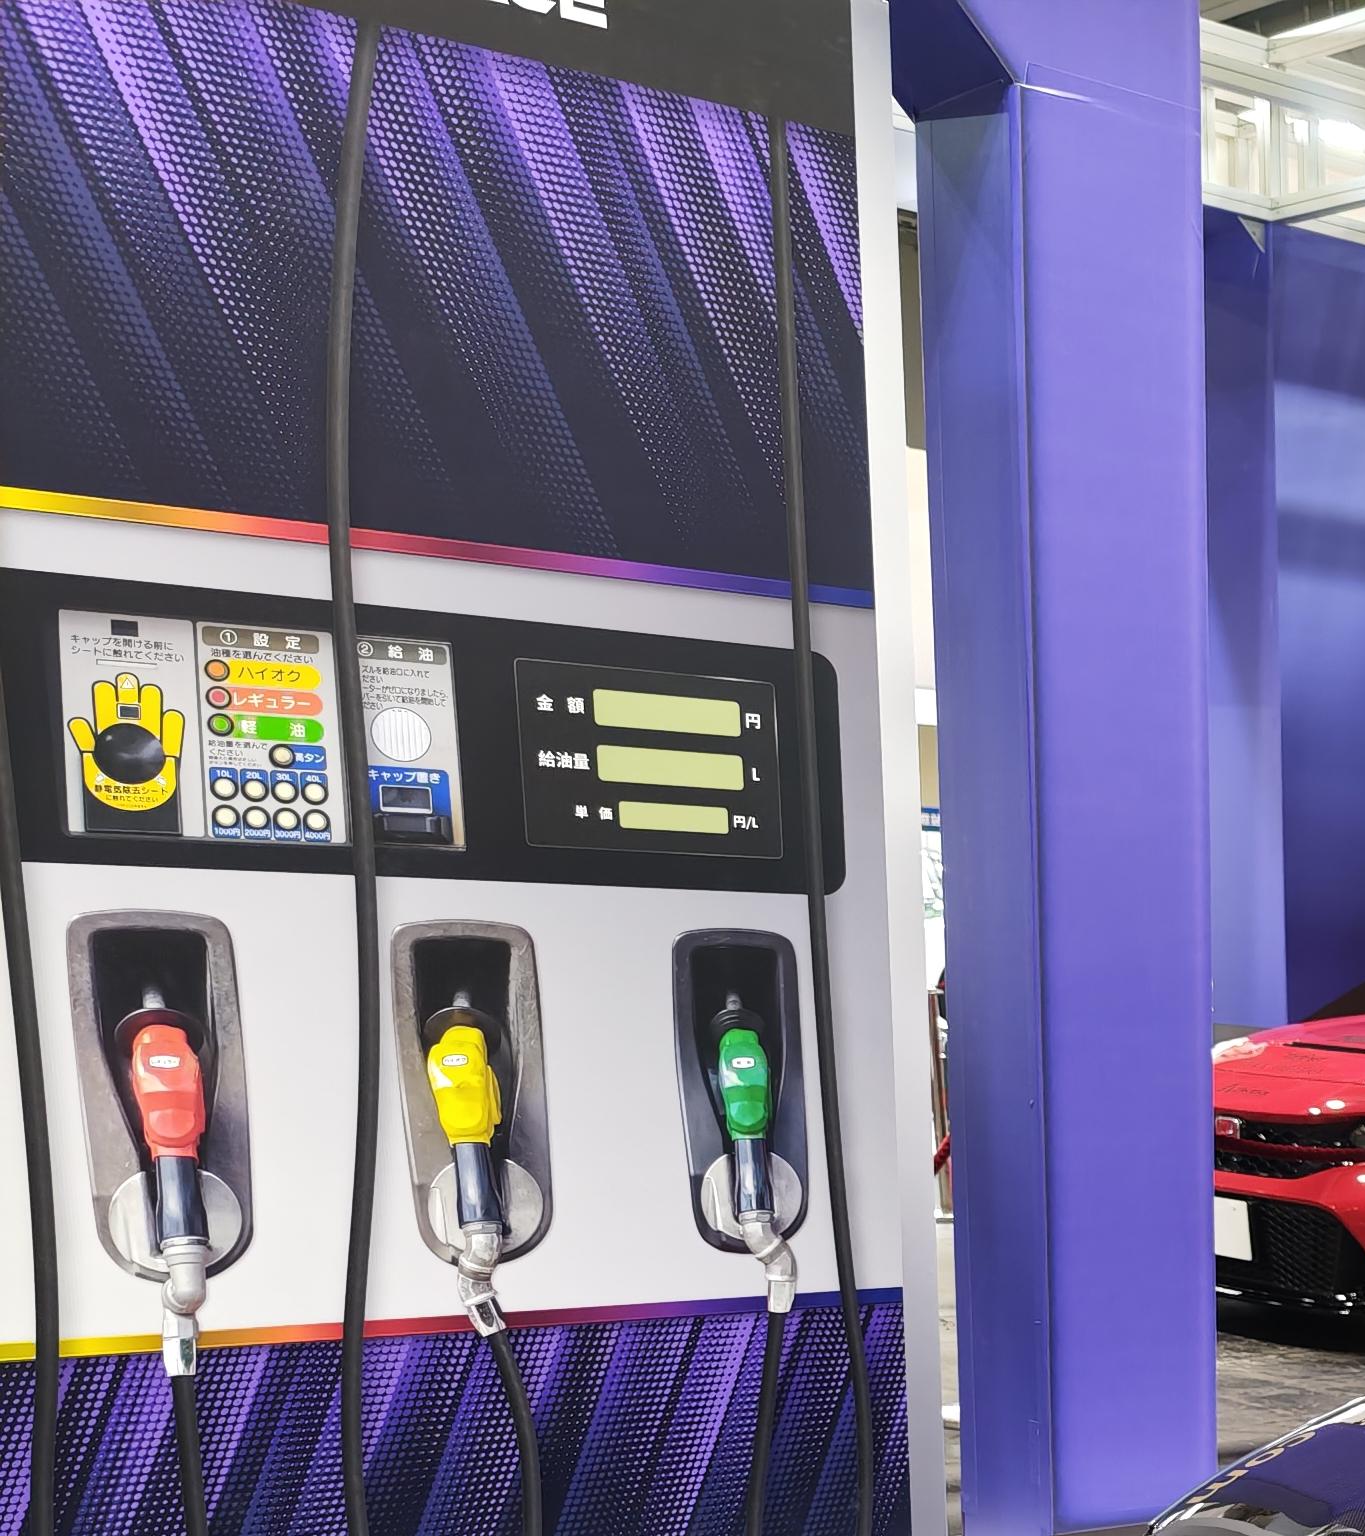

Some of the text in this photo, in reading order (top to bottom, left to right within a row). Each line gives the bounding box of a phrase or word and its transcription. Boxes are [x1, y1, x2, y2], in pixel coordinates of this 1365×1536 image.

[237, 667, 301, 683] ハイオク
[232, 691, 311, 710] レギュラー
[745, 712, 761, 730] 円
[537, 750, 761, 782] 給油量 L
[216, 769, 232, 778] 10L
[245, 771, 263, 780] 20L
[275, 772, 293, 781] 30L
[305, 774, 322, 783] 40L
[733, 814, 759, 830] 円/L
[214, 826, 241, 837] 1000円
[244, 828, 271, 838] 2000円
[275, 829, 301, 840] 3000円
[305, 831, 331, 841] 4000円
